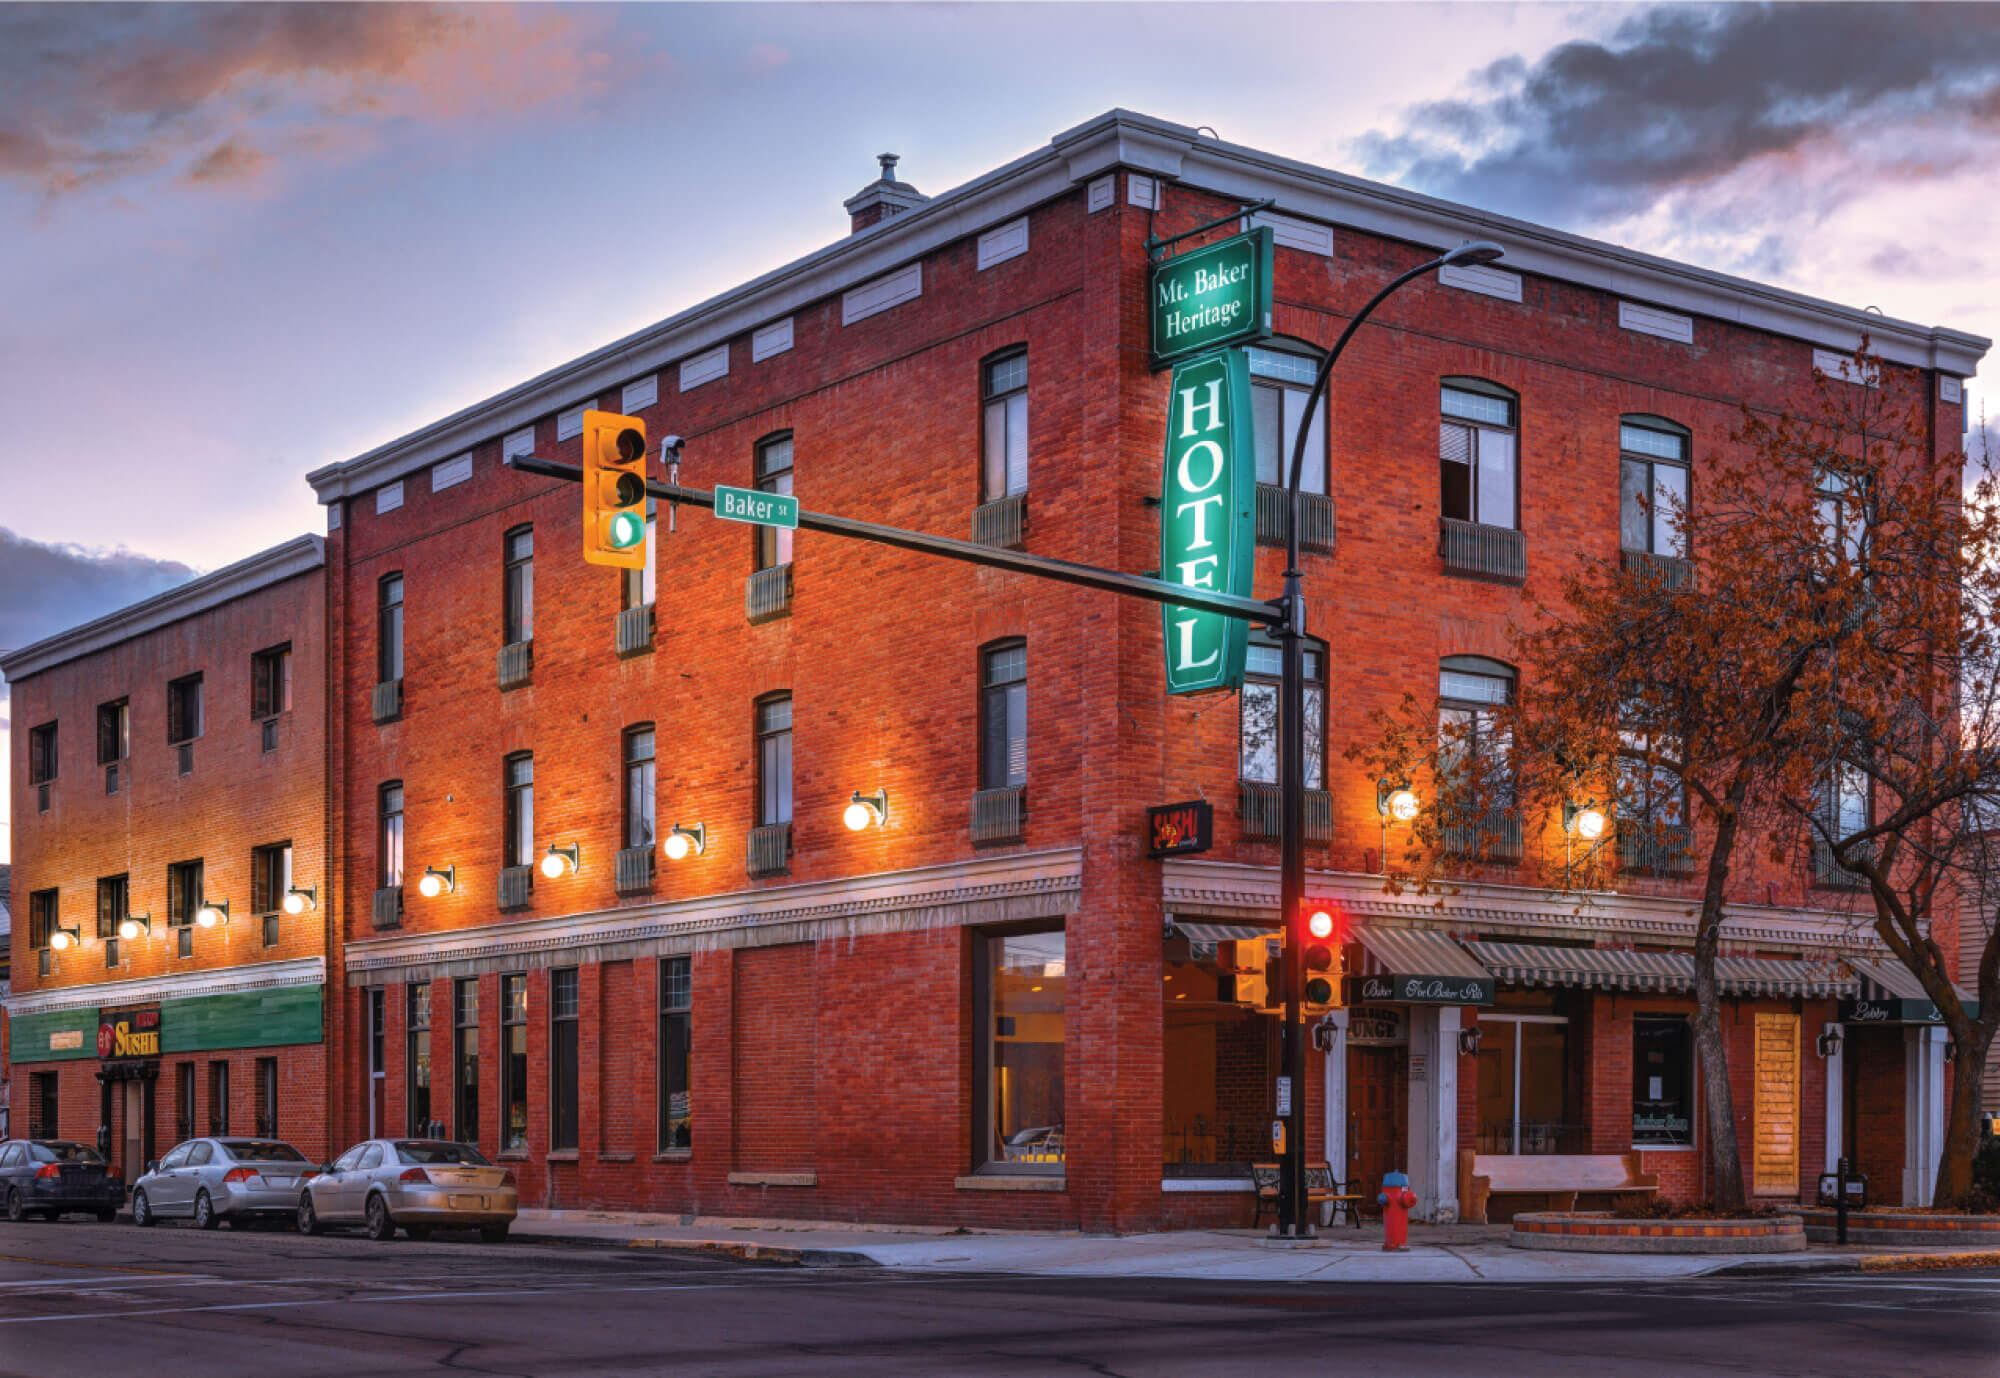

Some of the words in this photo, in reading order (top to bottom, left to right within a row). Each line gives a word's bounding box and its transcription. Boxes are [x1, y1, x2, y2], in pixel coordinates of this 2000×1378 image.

[1159, 278, 1189, 306] Mt.
[1195, 262, 1249, 295] Baker
[1166, 299, 1241, 339] Heritage
[725, 493, 774, 519] Baker
[1176, 377, 1225, 671] HOTEL
[1362, 979, 1393, 998] Baker
[1426, 981, 1458, 999] Baker
[1850, 1001, 1889, 1021] Lobby
[1352, 1021, 1397, 1039] UNGE
